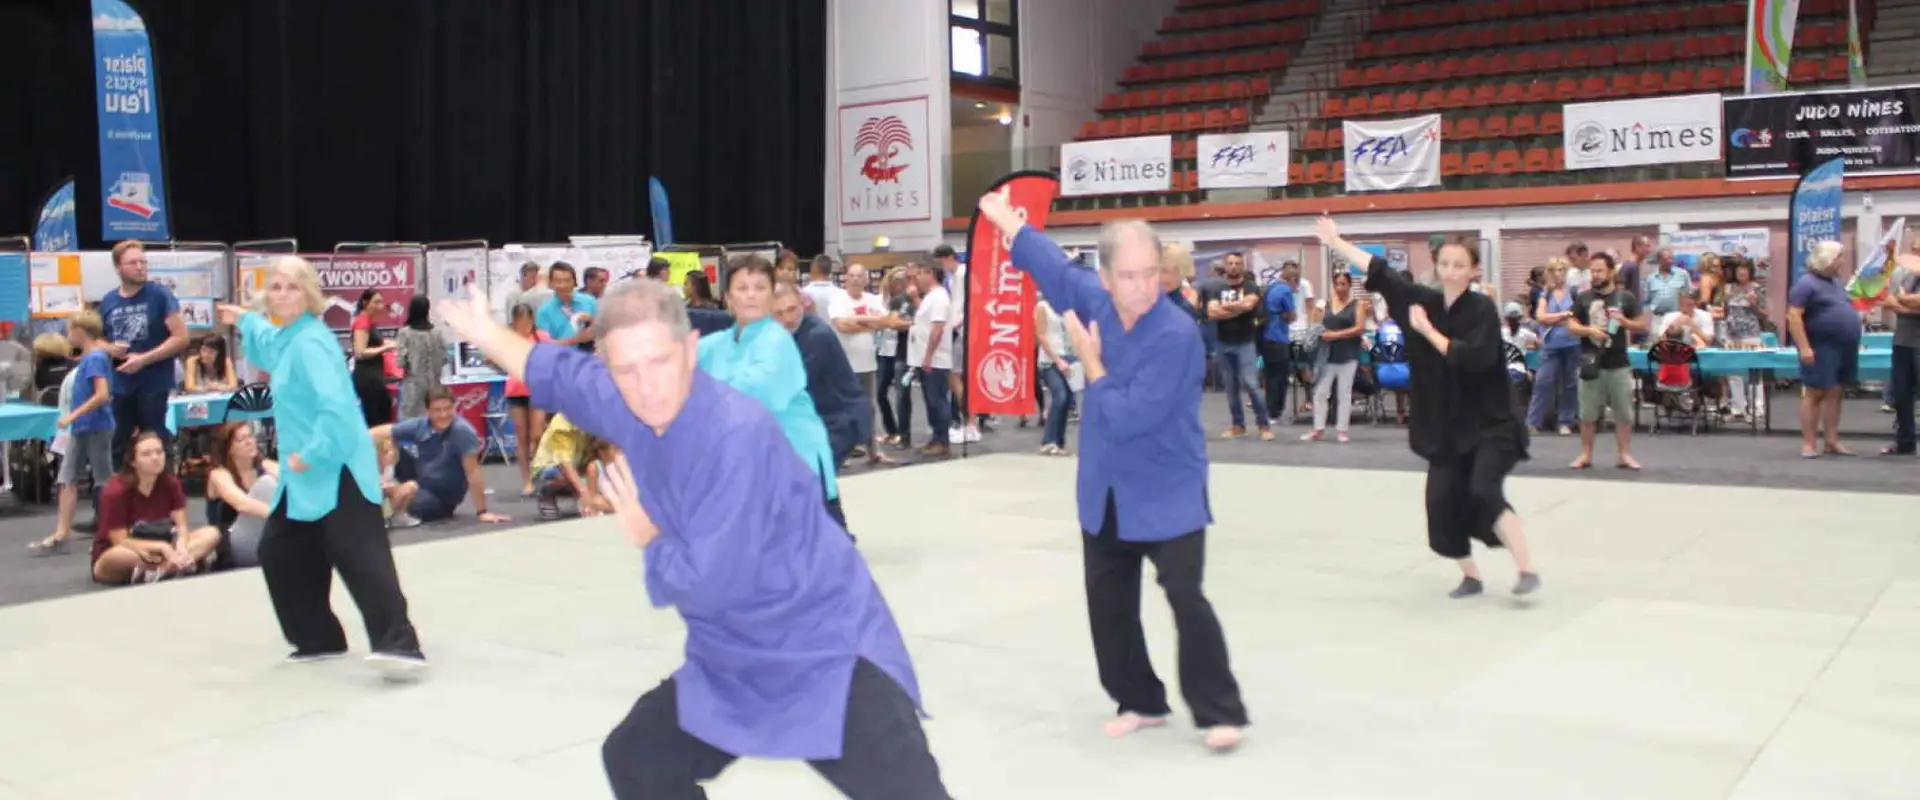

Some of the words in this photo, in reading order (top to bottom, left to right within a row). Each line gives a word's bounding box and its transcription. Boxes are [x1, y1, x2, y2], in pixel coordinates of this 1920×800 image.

[1795, 104, 1840, 121] JUDO
[1610, 121, 1714, 153] Nîmes
[1210, 144, 1254, 168] FFA
[1352, 134, 1408, 166] FFA
[1093, 157, 1167, 182] Nîmes
[849, 187, 920, 211] NÎMES
